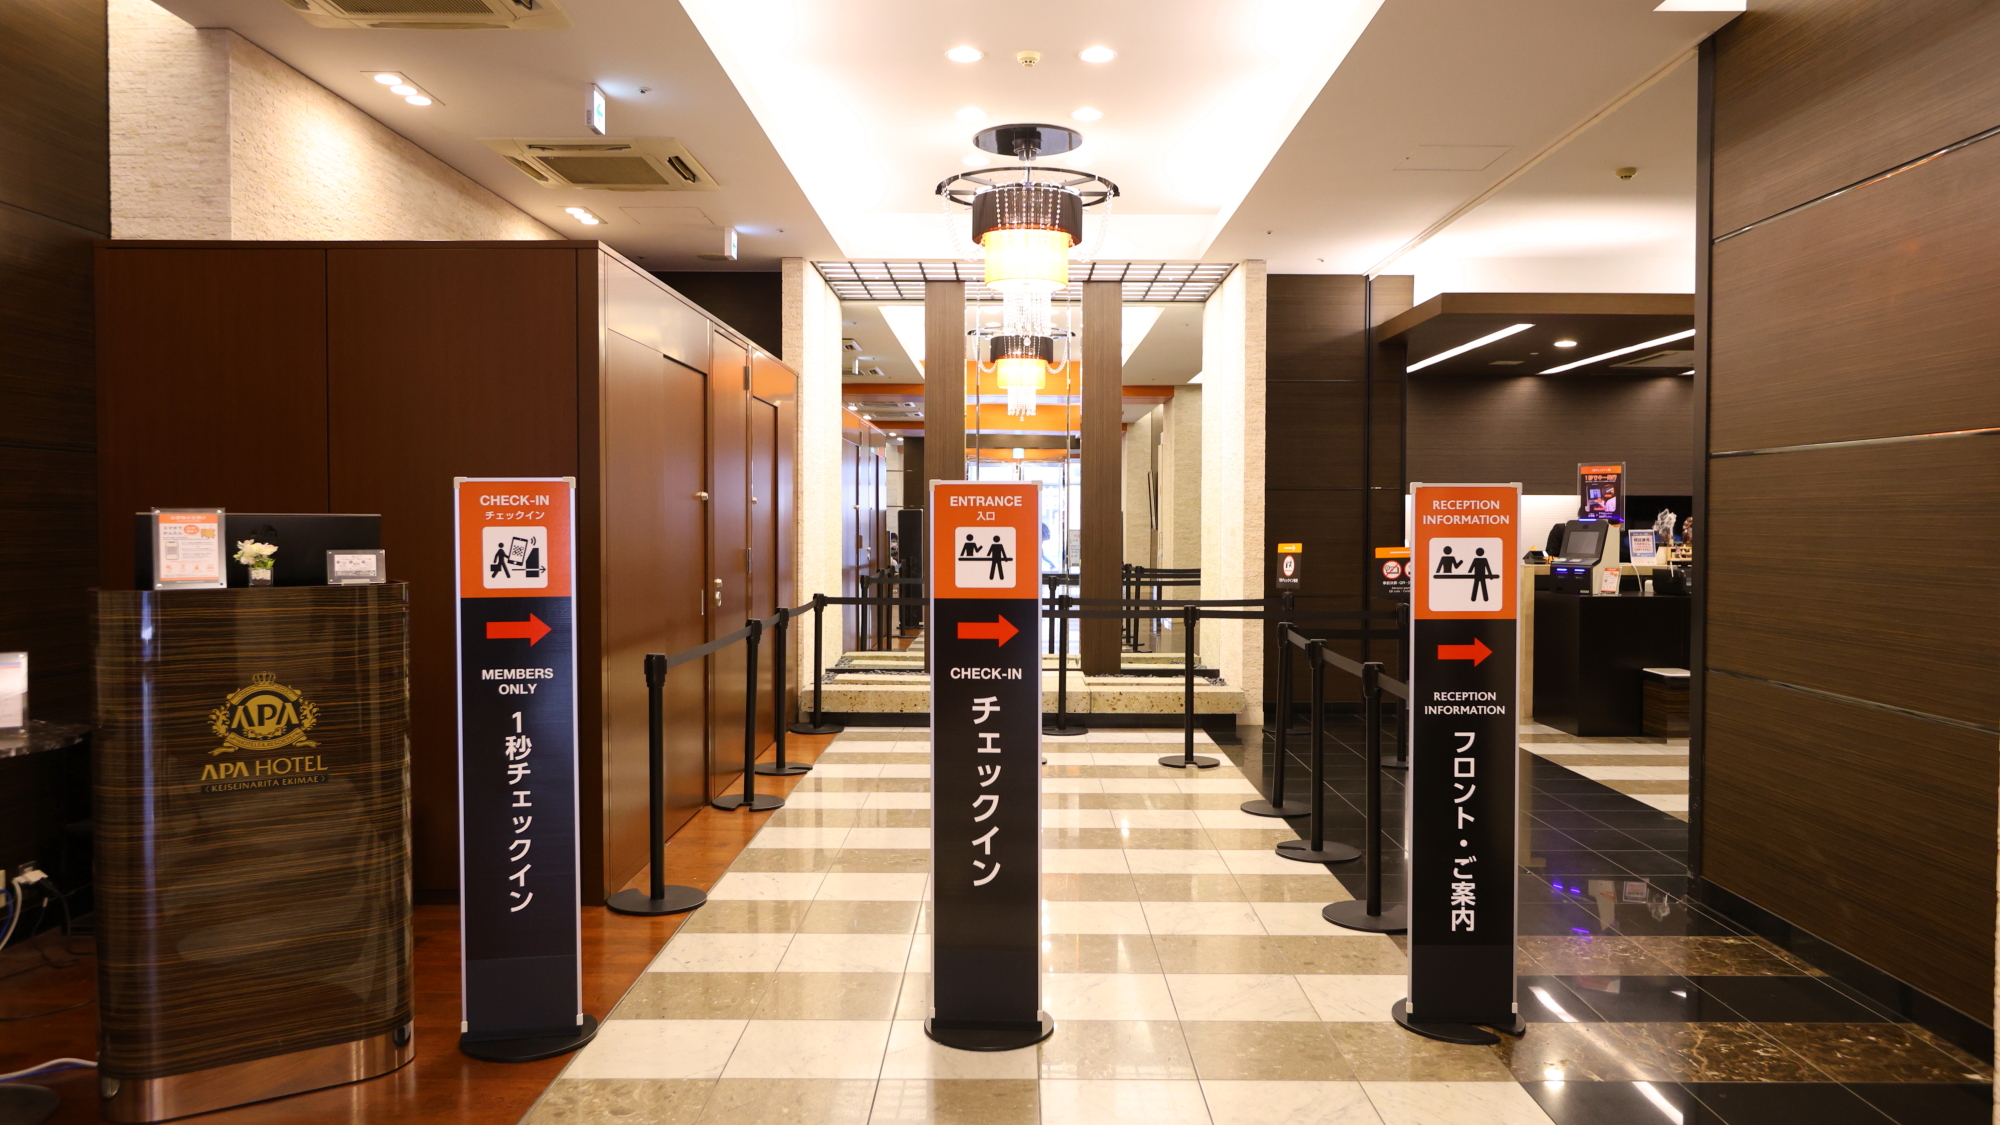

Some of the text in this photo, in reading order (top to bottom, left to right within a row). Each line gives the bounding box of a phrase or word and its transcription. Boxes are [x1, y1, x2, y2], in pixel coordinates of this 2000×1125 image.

[479, 494, 550, 507] CHECK-IN
[949, 495, 1023, 507] ENTRANCE
[1432, 499, 1500, 510] RECEPTION
[485, 510, 545, 521] チェックイン
[976, 511, 996, 521] 入口
[1422, 514, 1510, 525] INFORMATION
[481, 667, 554, 681] MEMBERS
[950, 667, 1022, 680] CHECK-IN
[498, 683, 538, 695] ONLY
[1433, 691, 1497, 702] RECEPTION
[231, 702, 299, 729] APA
[1424, 705, 1506, 715] INFORMATION
[200, 755, 328, 781] APA HOTEL
[971, 695, 1002, 887] チェックイン
[505, 711, 534, 914] 1秒チェックイン
[1450, 731, 1477, 932] フロント・ご案内
